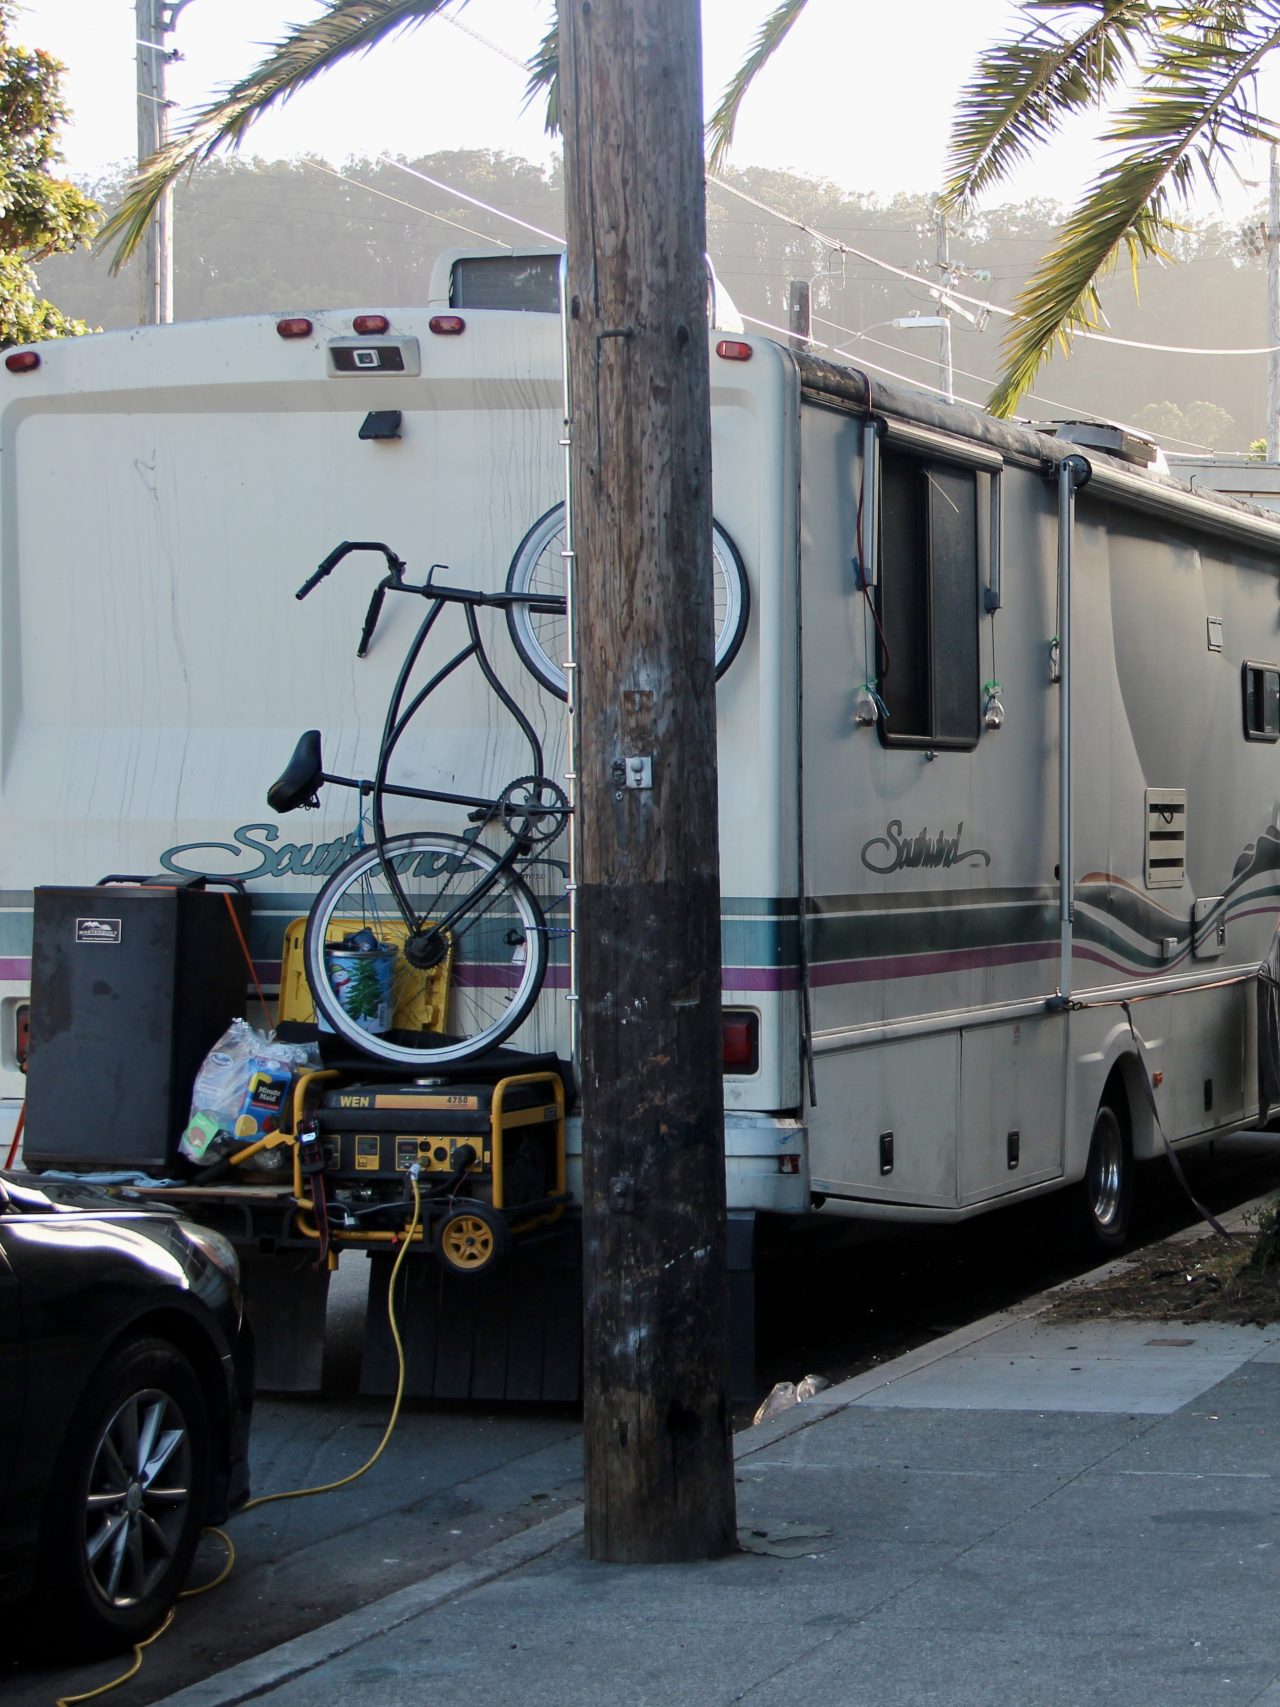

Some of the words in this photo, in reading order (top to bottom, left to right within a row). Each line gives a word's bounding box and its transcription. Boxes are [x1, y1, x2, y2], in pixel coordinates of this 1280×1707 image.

[258, 1086, 281, 1096] Minute
[259, 1093, 276, 1102] Maid
[340, 1096, 369, 1107] WEN
[447, 1096, 468, 1104] 4750
